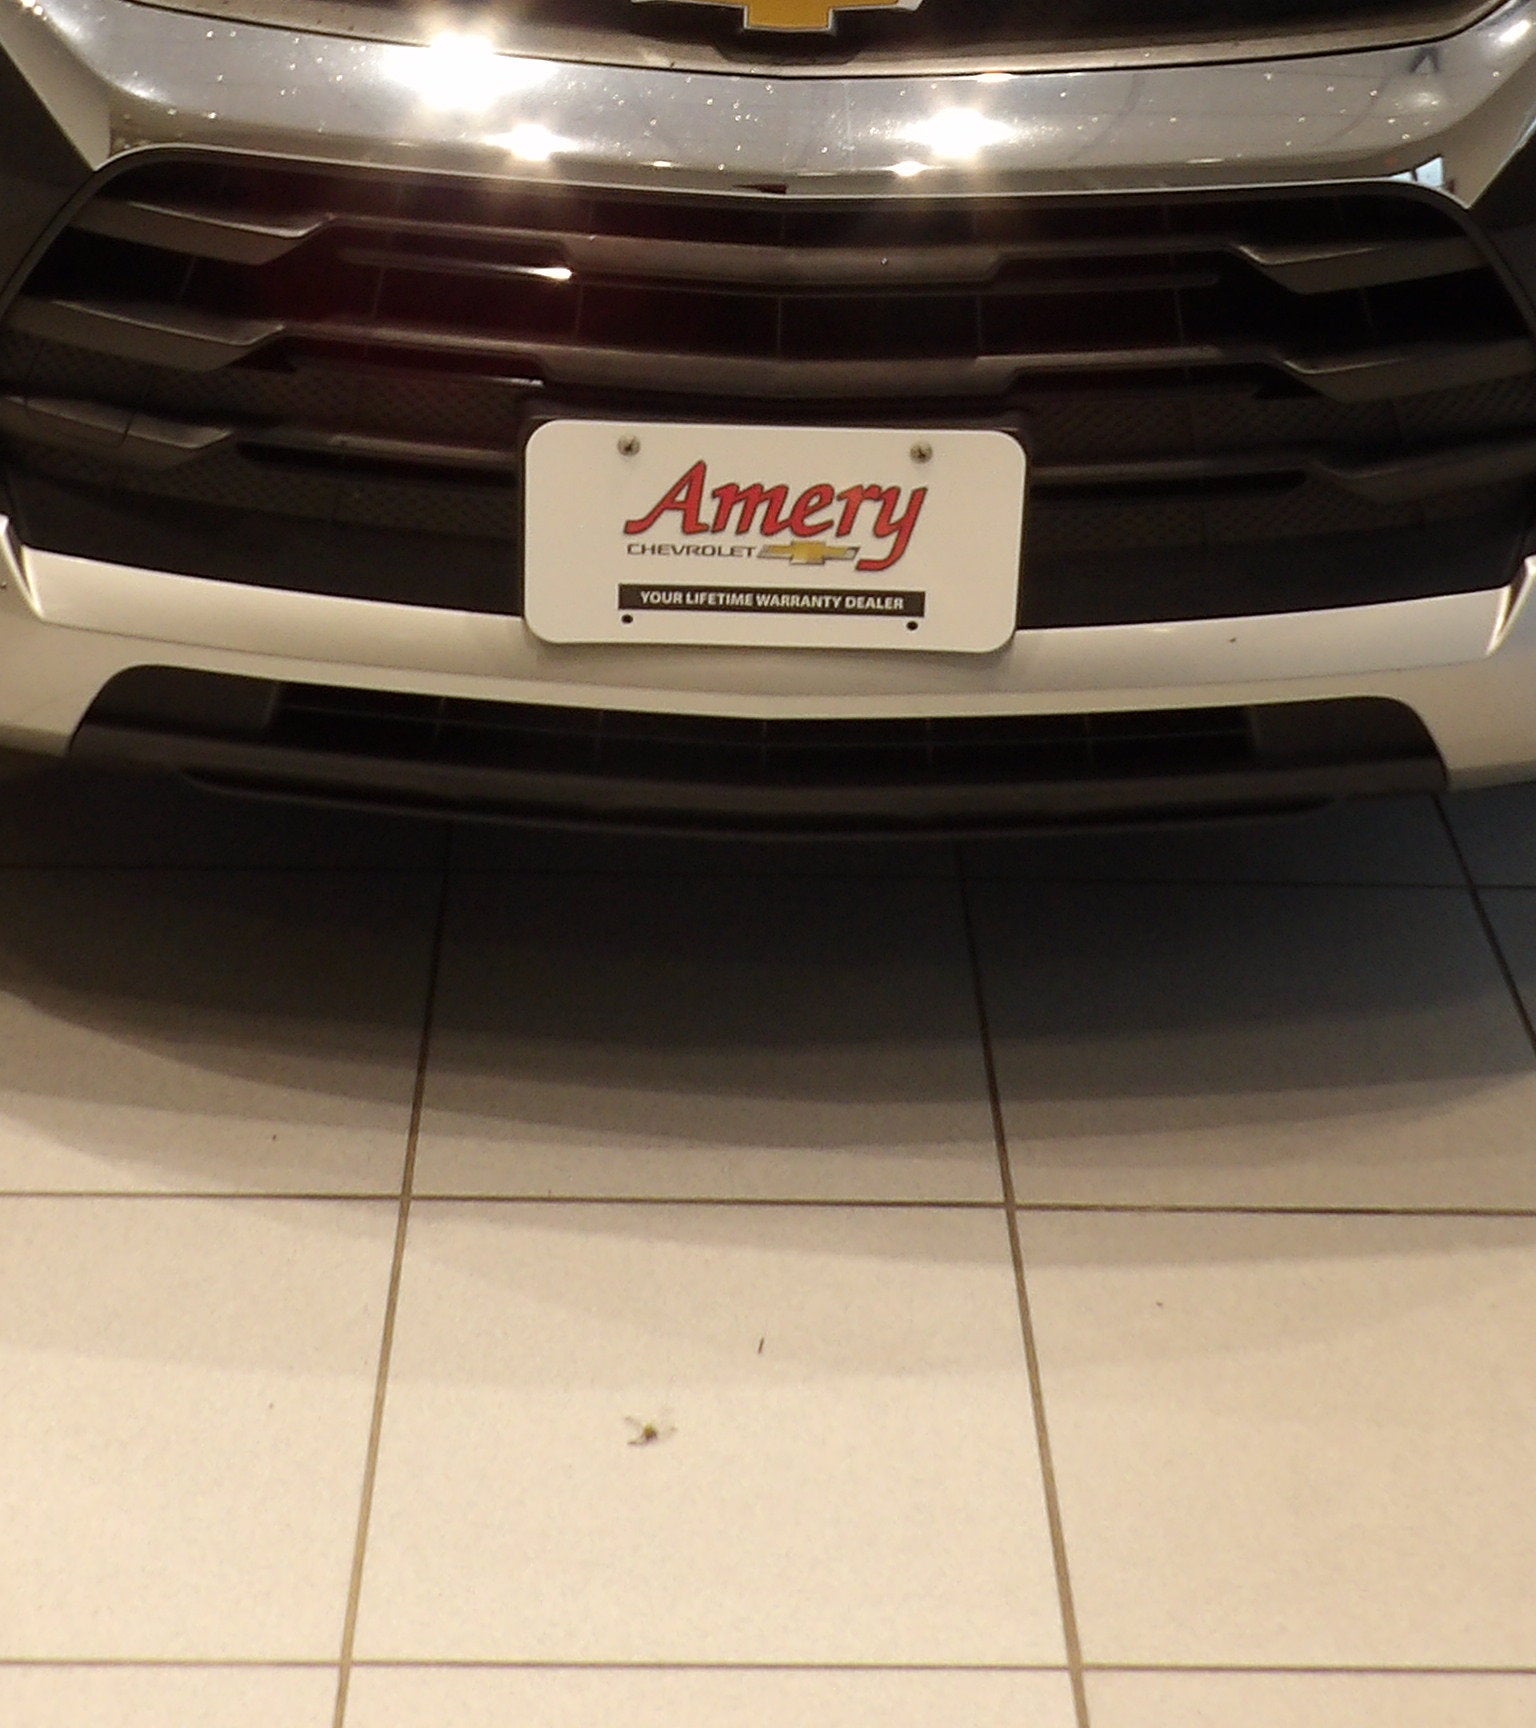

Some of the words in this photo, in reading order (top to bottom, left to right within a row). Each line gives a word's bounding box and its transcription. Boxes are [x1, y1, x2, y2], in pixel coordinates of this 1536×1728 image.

[623, 459, 928, 572] Amery
[627, 543, 756, 558] CHEVROLET
[641, 590, 683, 605] YOUR
[685, 591, 754, 607] LIFETIME
[756, 593, 842, 610] WARRANTY
[844, 595, 905, 611] DEALER
